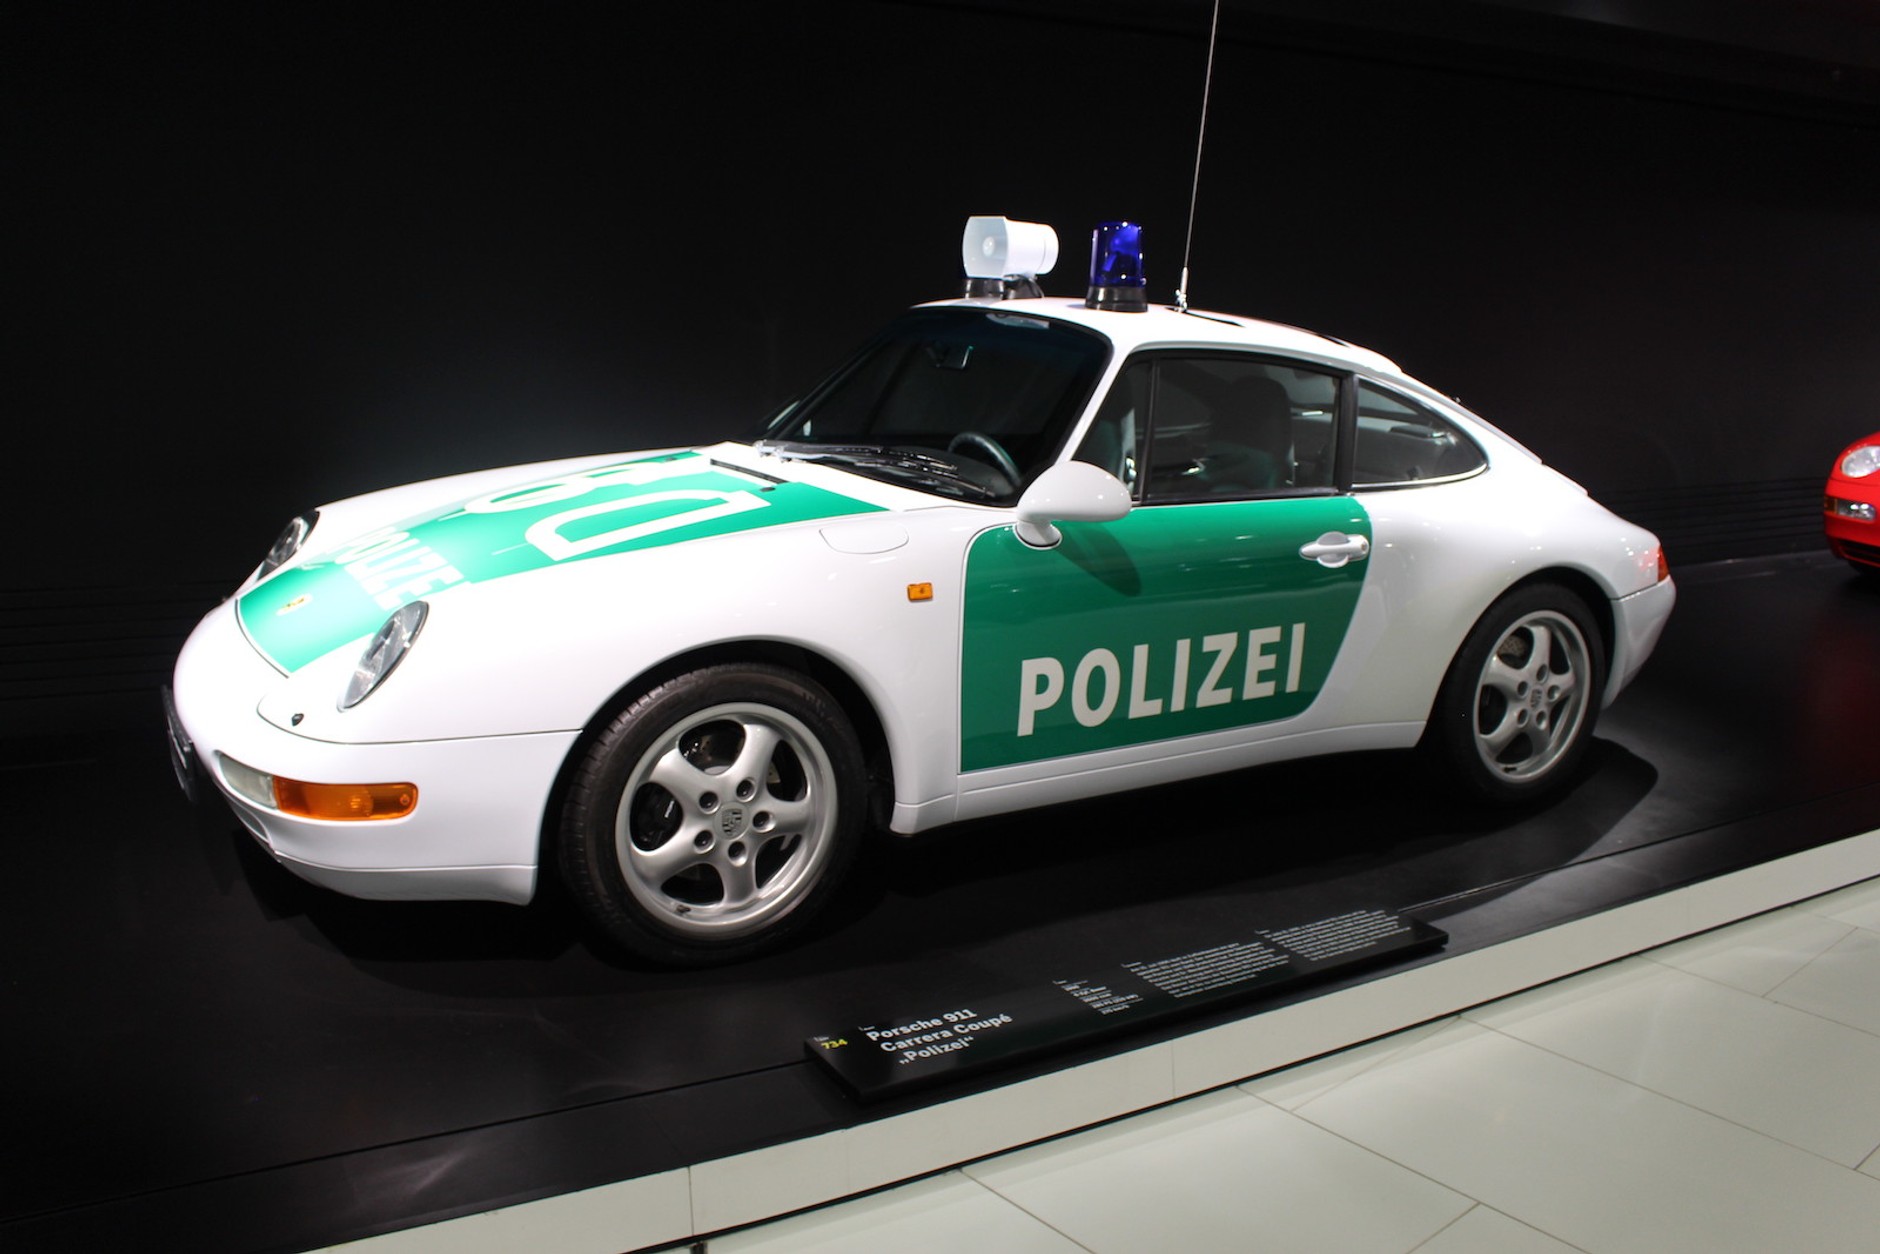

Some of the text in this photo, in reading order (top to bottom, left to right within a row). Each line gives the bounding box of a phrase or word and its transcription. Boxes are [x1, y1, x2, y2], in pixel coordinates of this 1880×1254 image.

[1017, 622, 1306, 737] POLIZEI
[866, 1009, 978, 1041] Porsche 911
[880, 1013, 1013, 1052] Carrera Coupé
[821, 1038, 848, 1050] 734
